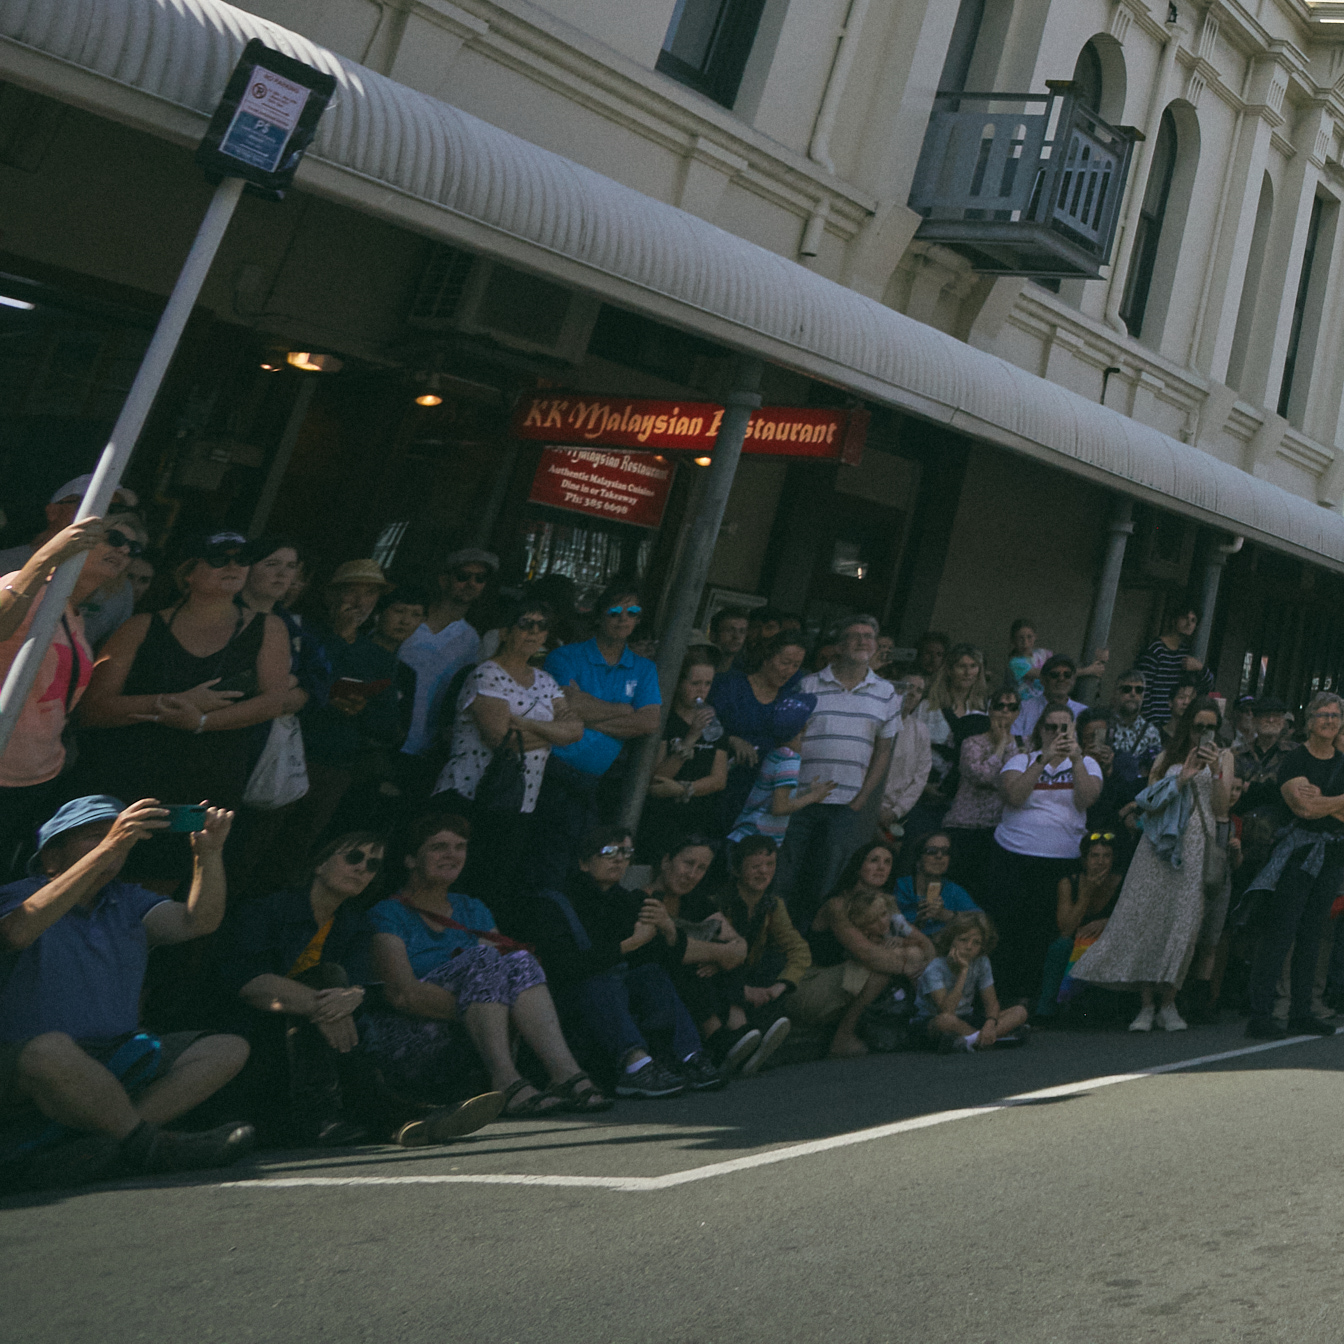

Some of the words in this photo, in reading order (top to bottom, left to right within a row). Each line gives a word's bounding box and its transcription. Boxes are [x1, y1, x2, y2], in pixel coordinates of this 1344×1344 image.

[523, 399, 568, 429] KK
[566, 403, 704, 443] Malaysian
[704, 409, 837, 445] staurant
[548, 464, 590, 482] Authentic
[589, 473, 628, 492] Malaysian
[560, 478, 581, 493] Dine
[580, 482, 590, 494] in
[589, 487, 600, 497] or
[599, 487, 639, 506] Takeaway
[583, 497, 603, 510] 385
